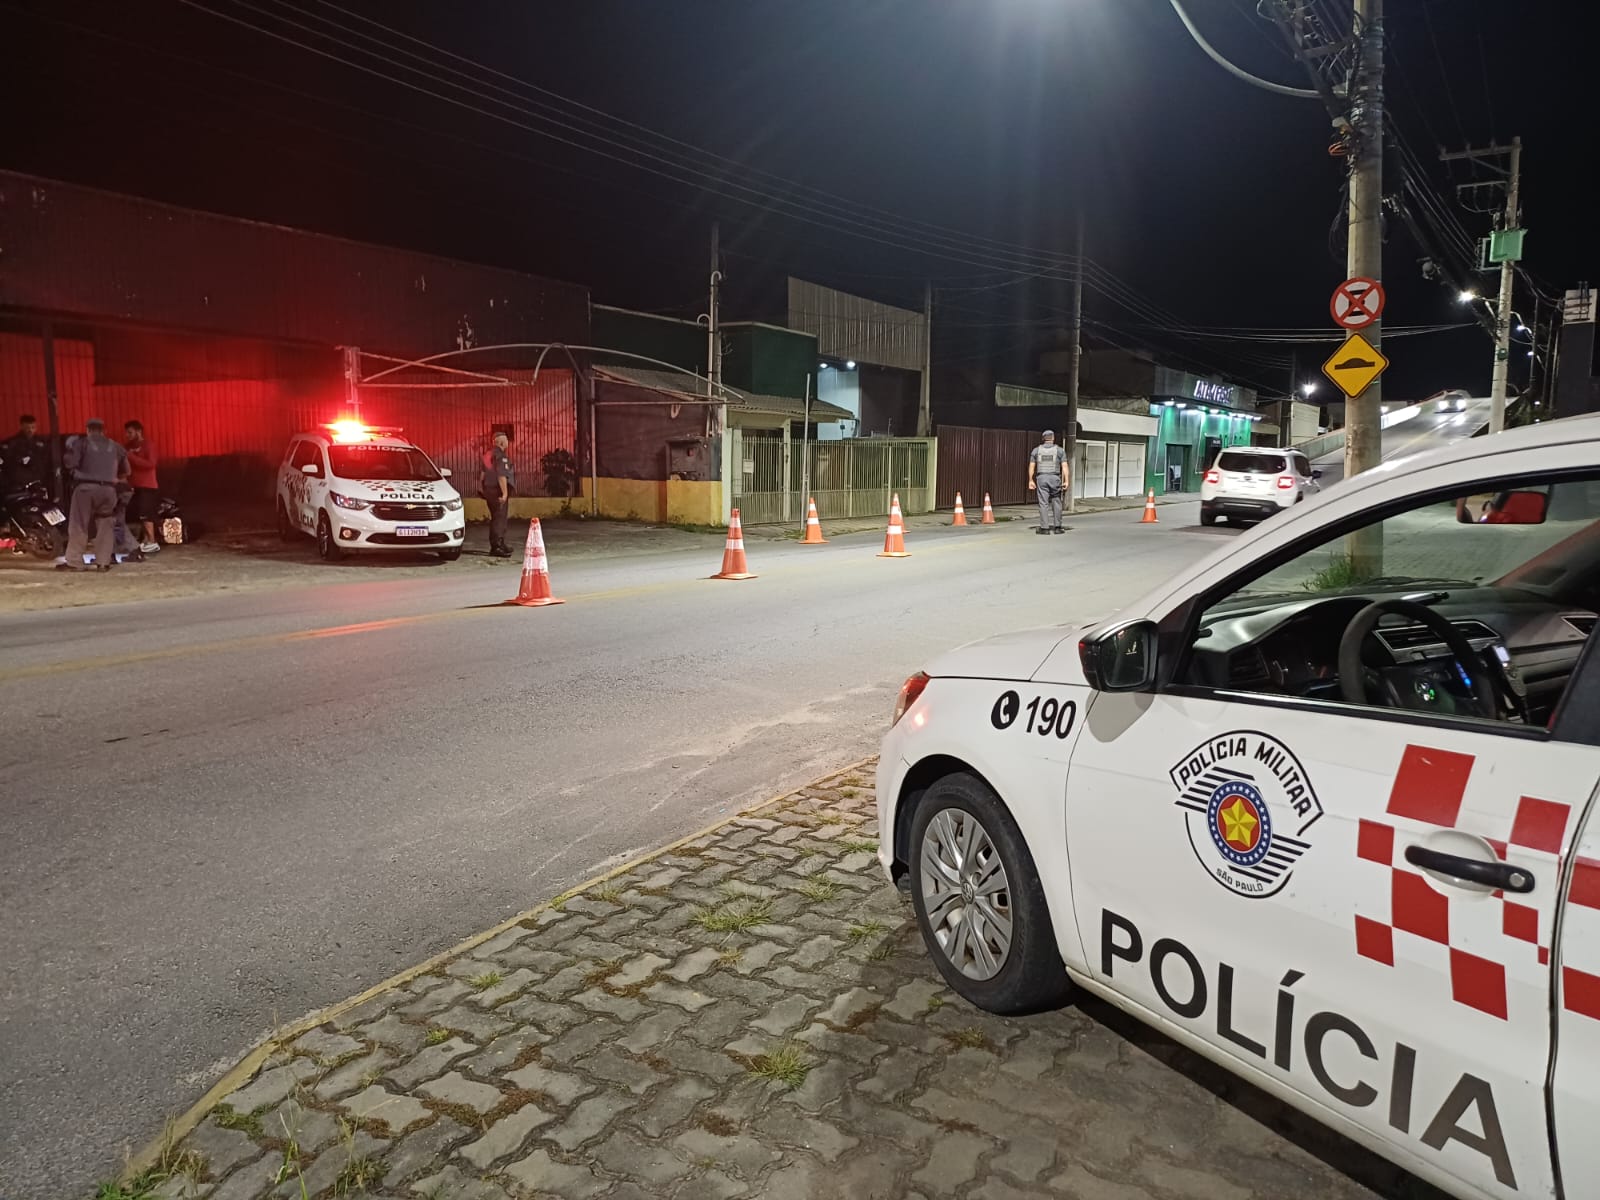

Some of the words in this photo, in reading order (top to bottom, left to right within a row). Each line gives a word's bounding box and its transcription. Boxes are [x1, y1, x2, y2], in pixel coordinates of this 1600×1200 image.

[1026, 695, 1077, 740] 190
[1178, 737, 1247, 785] POLÍCIA
[1254, 741, 1312, 818] MILITAR
[1216, 867, 1233, 885] SÃO
[1235, 881, 1264, 892] PAULO
[1101, 908, 1519, 1192] POLÍCIA
